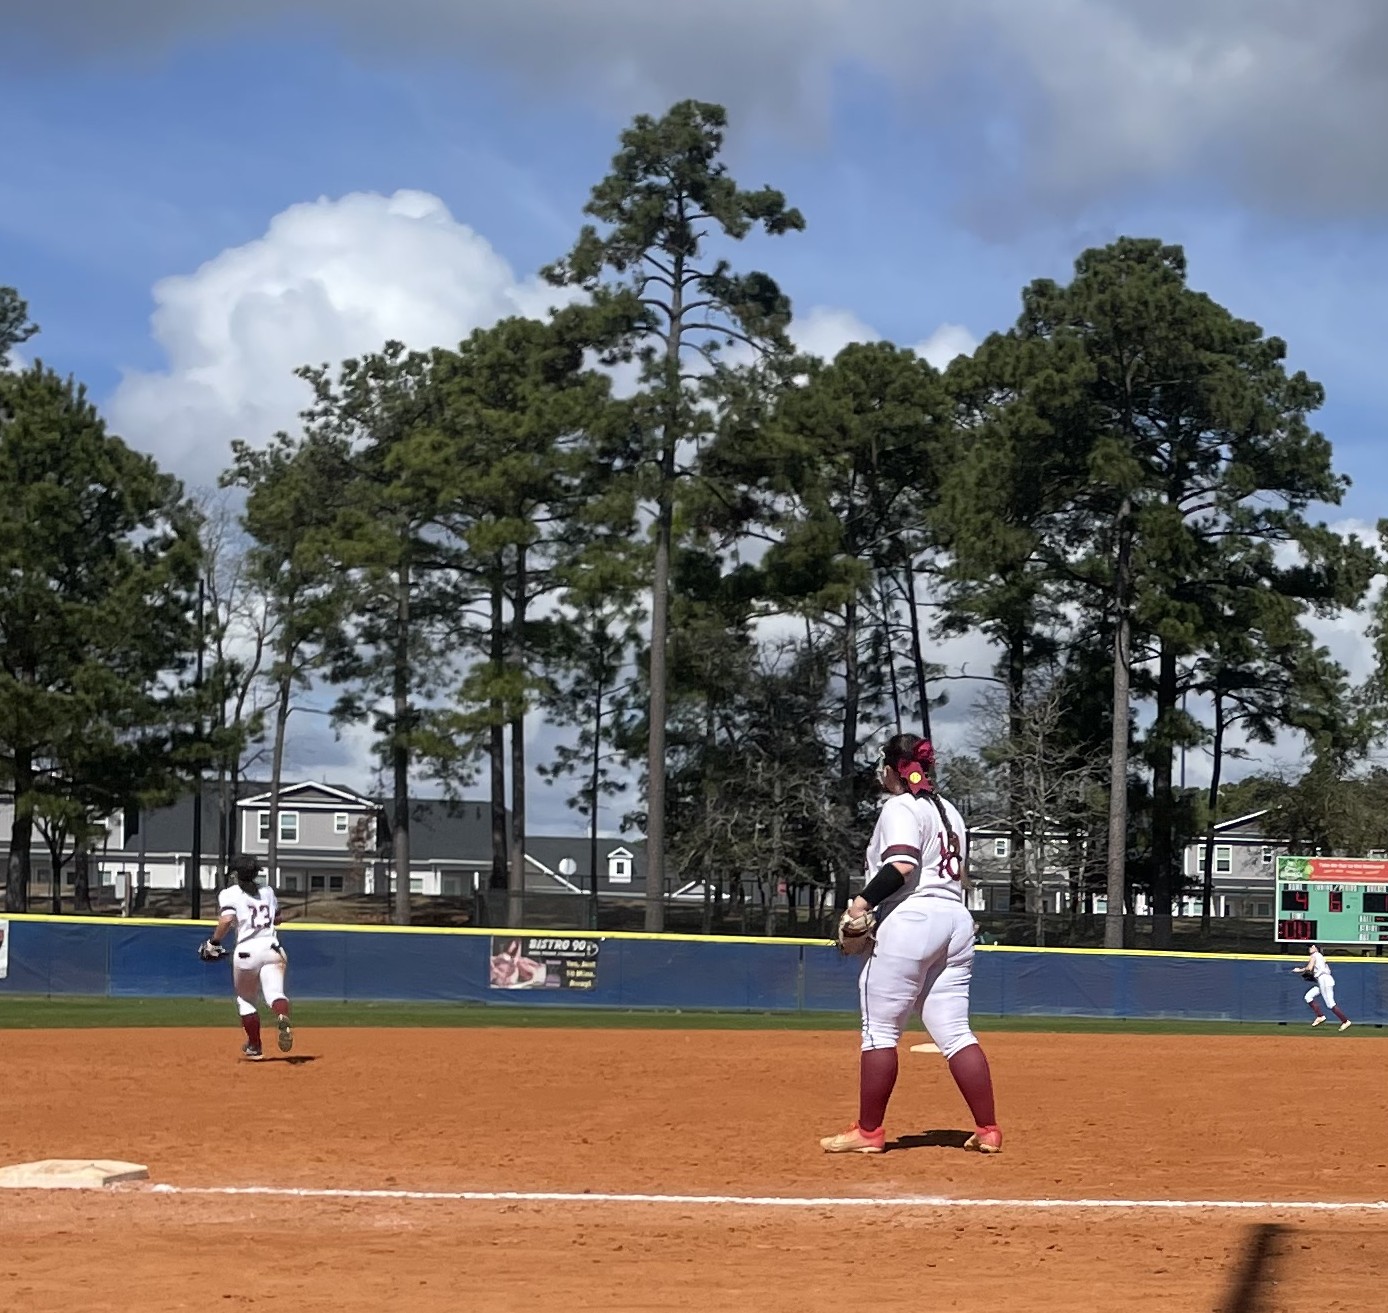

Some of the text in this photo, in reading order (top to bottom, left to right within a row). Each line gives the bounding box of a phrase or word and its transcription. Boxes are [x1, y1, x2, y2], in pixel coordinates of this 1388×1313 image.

[1296, 891, 1307, 910] 4
[1330, 891, 1342, 911] 6
[528, 938, 587, 951] BISTRO 90
